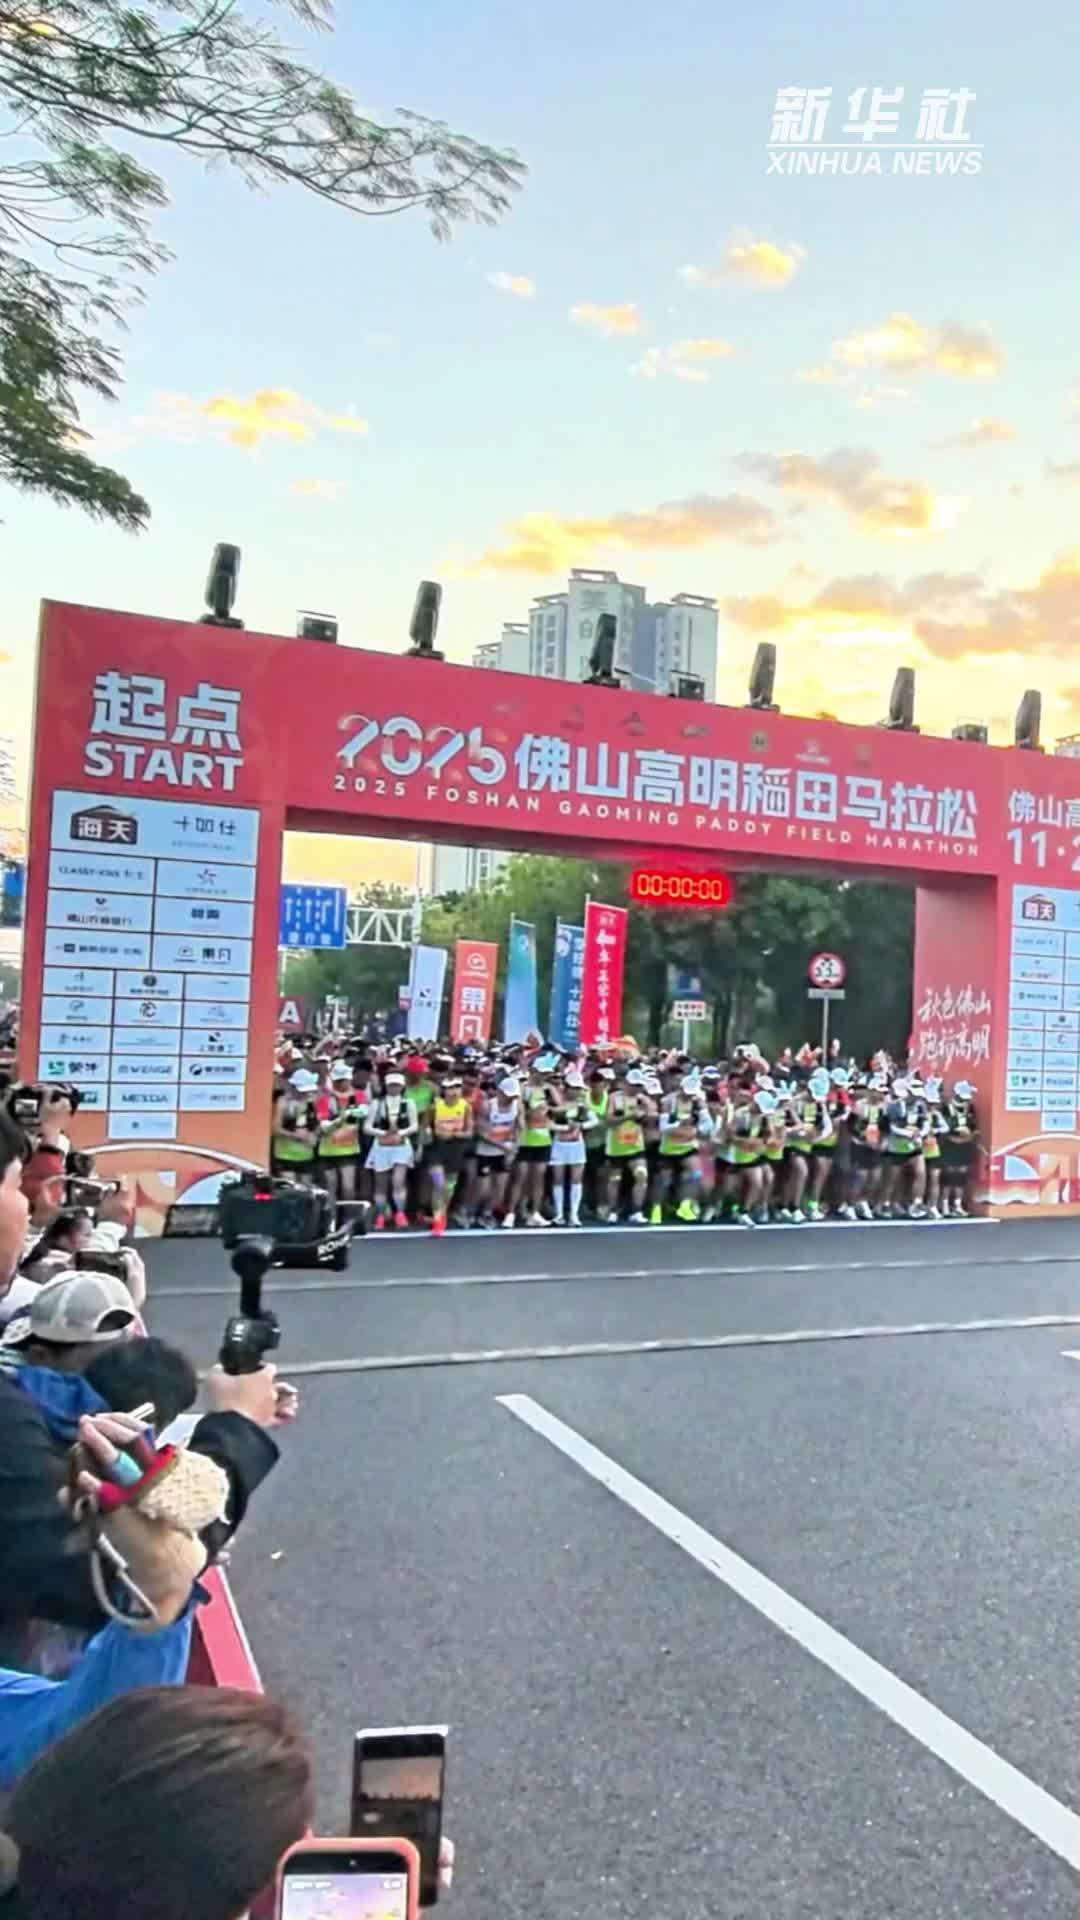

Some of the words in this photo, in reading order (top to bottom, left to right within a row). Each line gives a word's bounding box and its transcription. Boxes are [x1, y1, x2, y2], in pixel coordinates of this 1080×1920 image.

[90, 671, 242, 750] 起点
[84, 741, 244, 791] START
[78, 816, 132, 842] 海天
[334, 776, 406, 796] 2025
[427, 785, 540, 812] FOSHAN
[559, 801, 679, 827] GAOMING
[695, 816, 771, 837] PADDY
[786, 826, 852, 844] FIELD
[866, 834, 979, 858] MARATHON
[636, 873, 723, 901] 00:00:00
